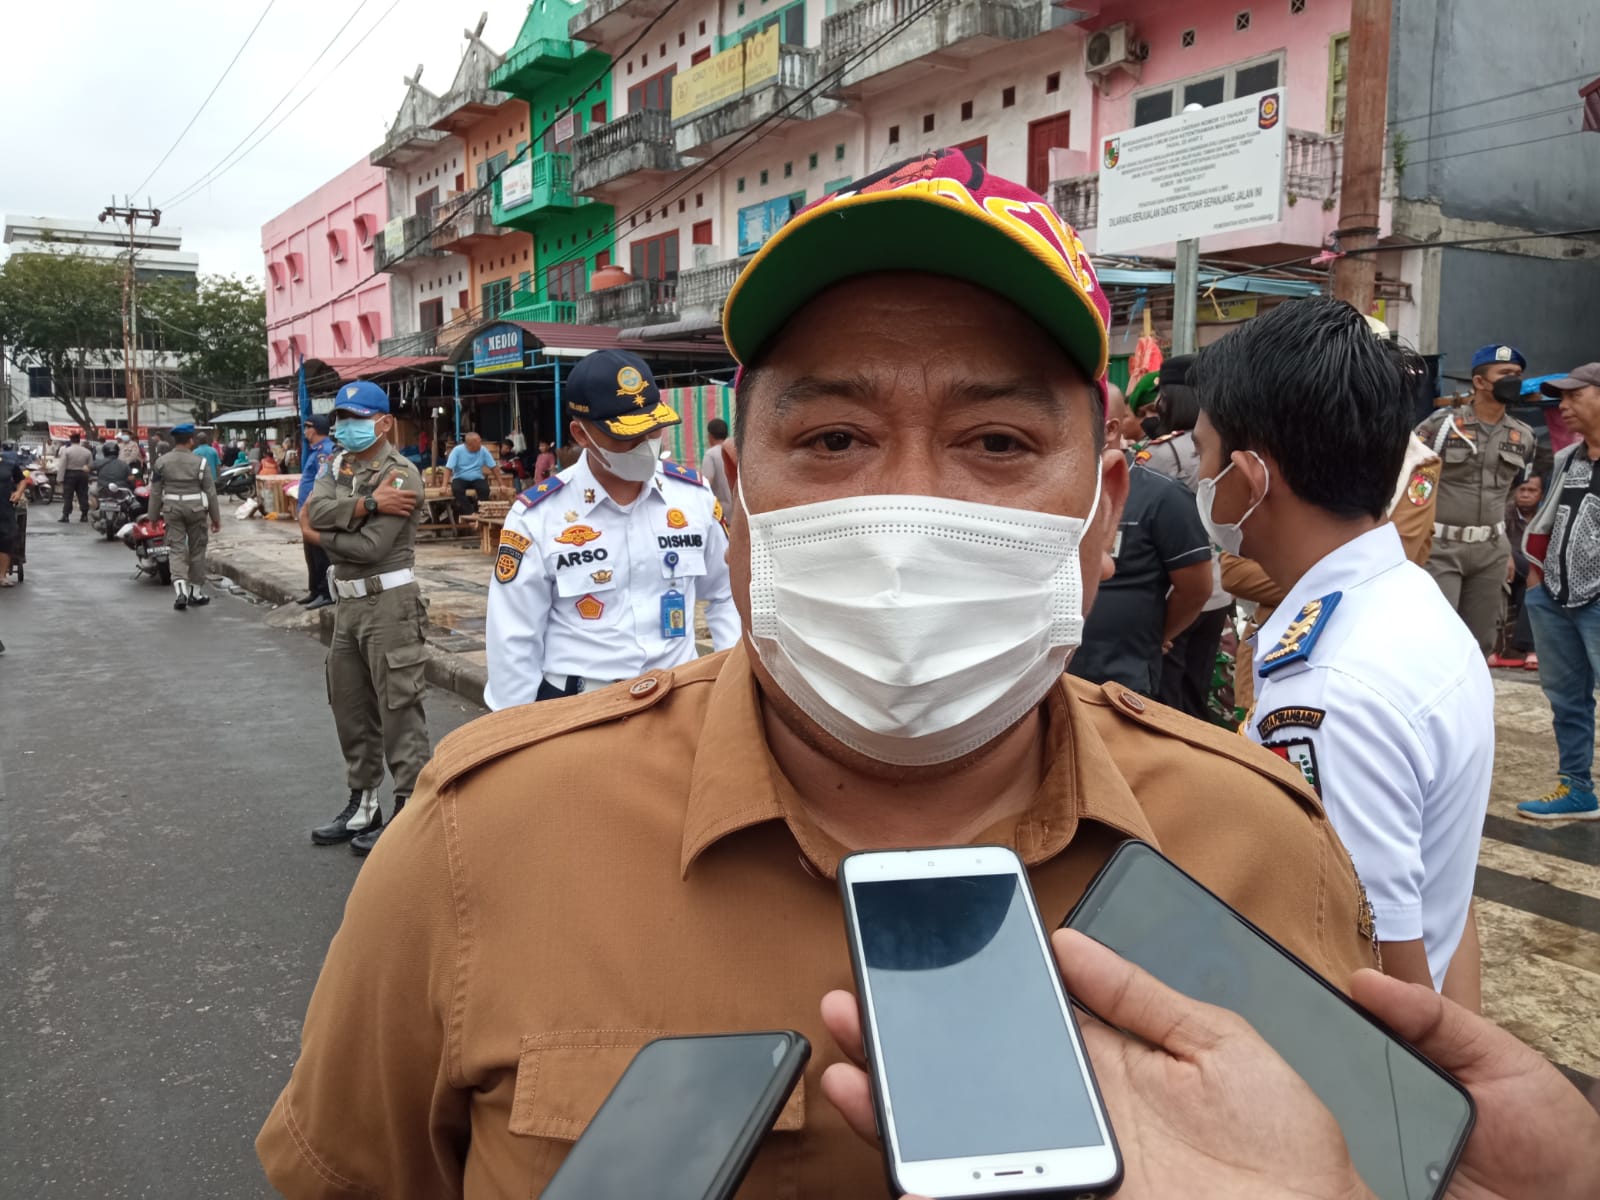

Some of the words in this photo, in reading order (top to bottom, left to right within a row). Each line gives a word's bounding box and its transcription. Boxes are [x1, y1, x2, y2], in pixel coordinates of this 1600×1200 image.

[1108, 213, 1131, 227] DILARANG
[1132, 207, 1160, 222] BERJUALAN
[1160, 203, 1177, 216] DIATAS
[1178, 198, 1202, 213] TROTOAR
[1203, 191, 1235, 208] SEPANJANG
[1235, 188, 1253, 201] JALAN
[1254, 186, 1262, 198] INI
[489, 331, 518, 351] MEDIO
[657, 534, 703, 549] DISHUB
[556, 548, 608, 570] ARSO
